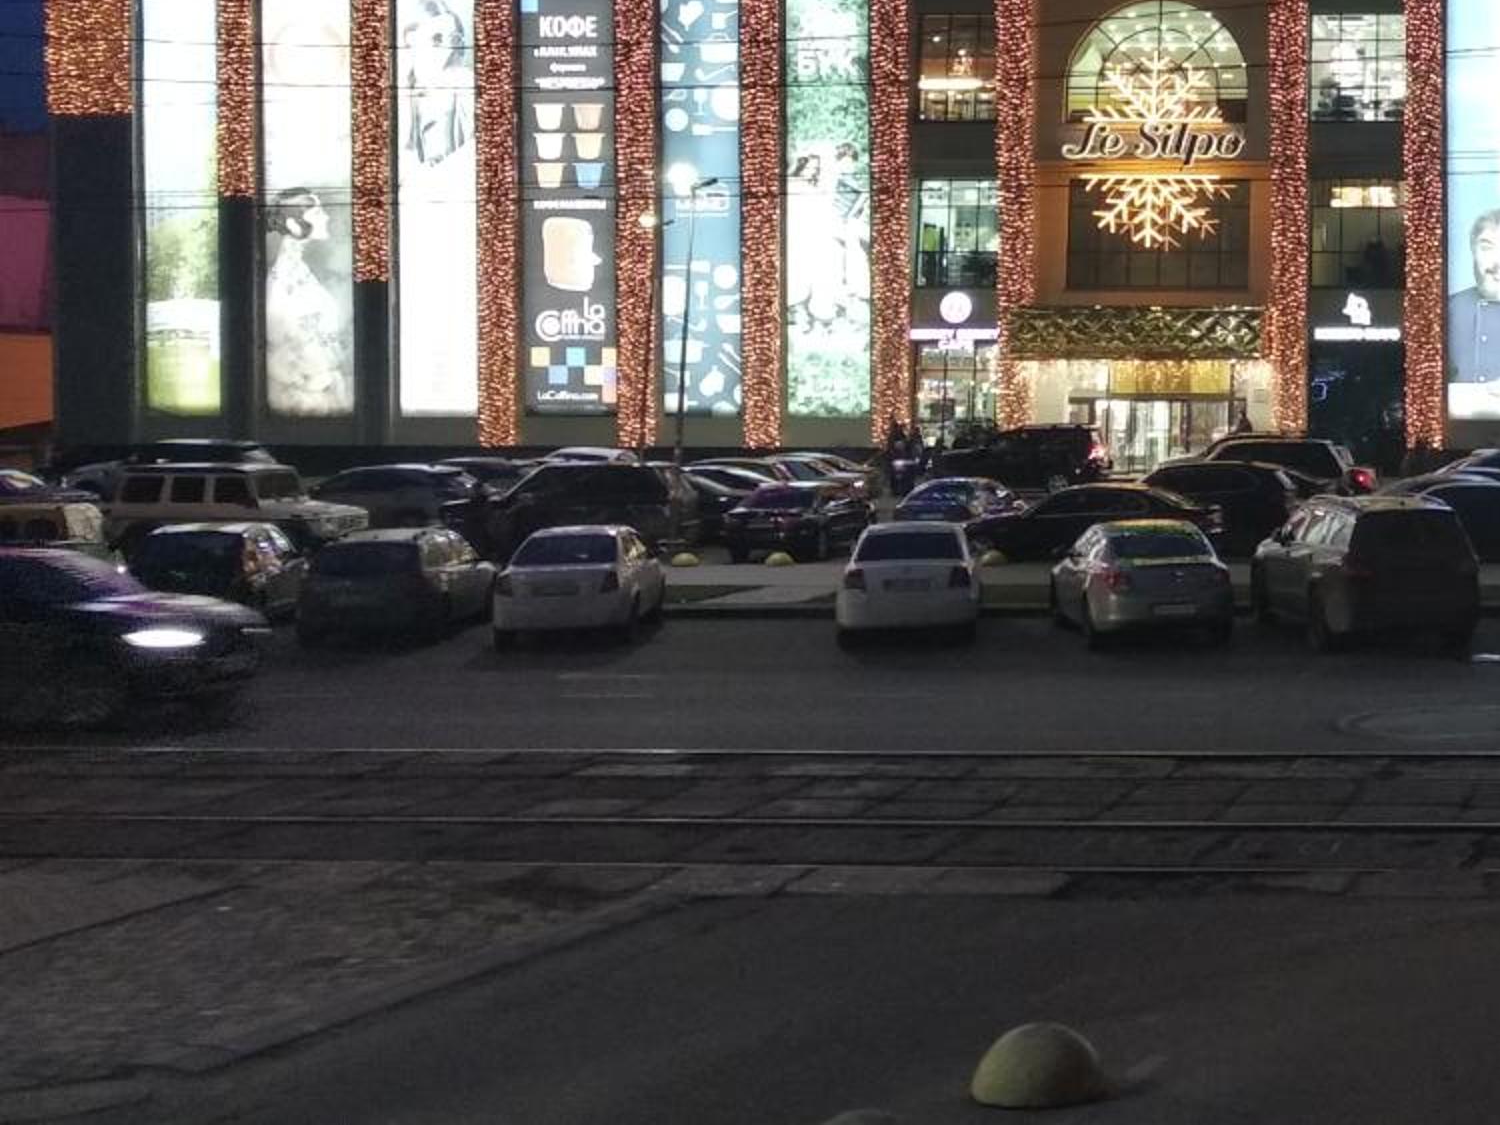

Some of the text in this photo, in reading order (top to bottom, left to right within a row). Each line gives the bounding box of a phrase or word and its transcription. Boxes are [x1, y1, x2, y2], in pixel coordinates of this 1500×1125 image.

[539, 15, 598, 39] КОФЕ
[1061, 122, 1247, 169] Le Silpo
